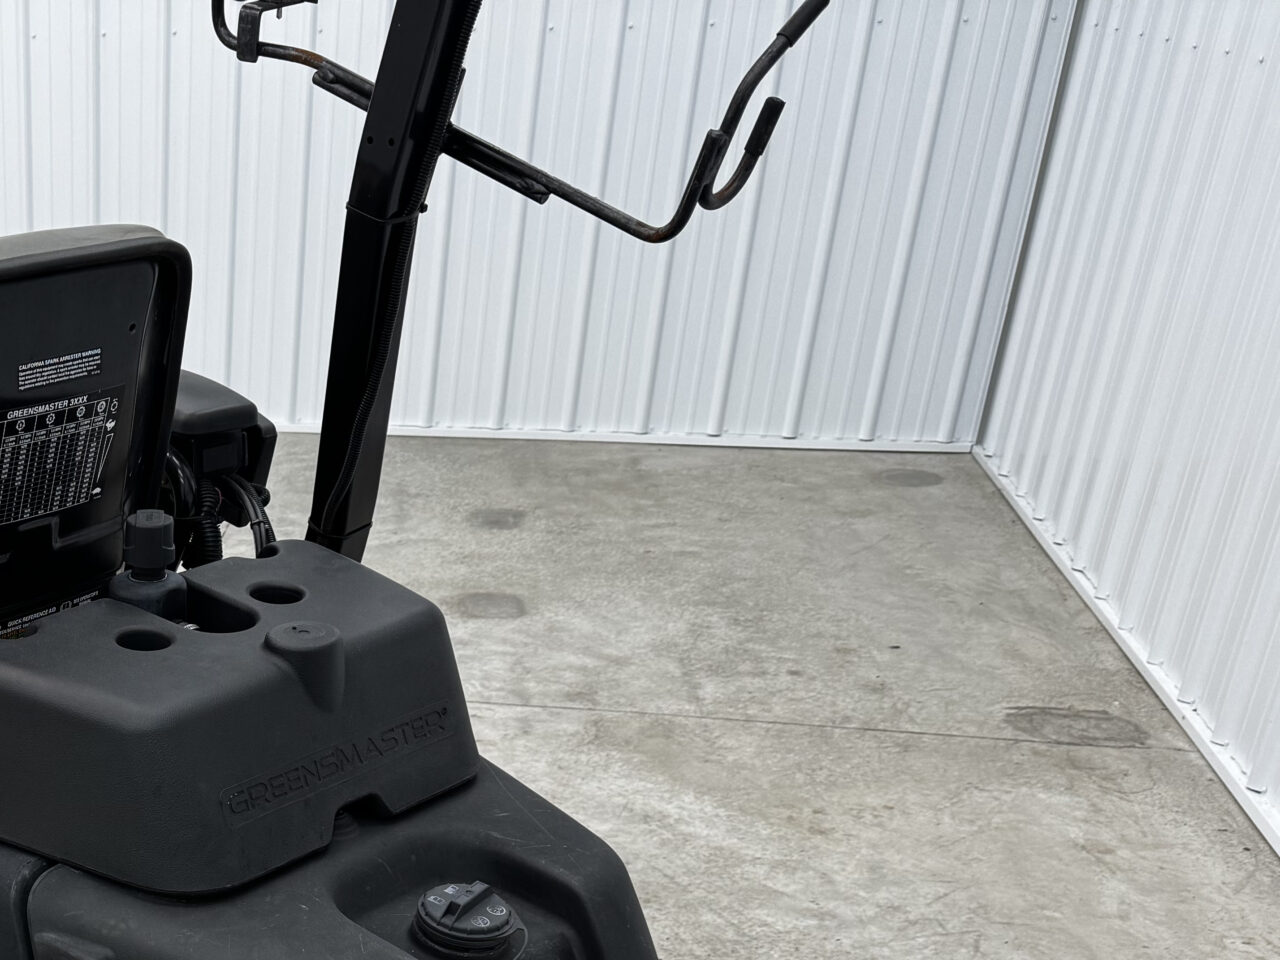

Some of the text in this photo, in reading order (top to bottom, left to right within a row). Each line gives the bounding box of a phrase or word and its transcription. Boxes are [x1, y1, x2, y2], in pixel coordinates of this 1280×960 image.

[18, 361, 44, 371] CALIFORNIA
[45, 357, 60, 365] SPARK
[7, 395, 88, 419] GREENSMASTER 3XXX
[7, 618, 22, 627] QUICK
[228, 708, 446, 815] GREENSMASTER
